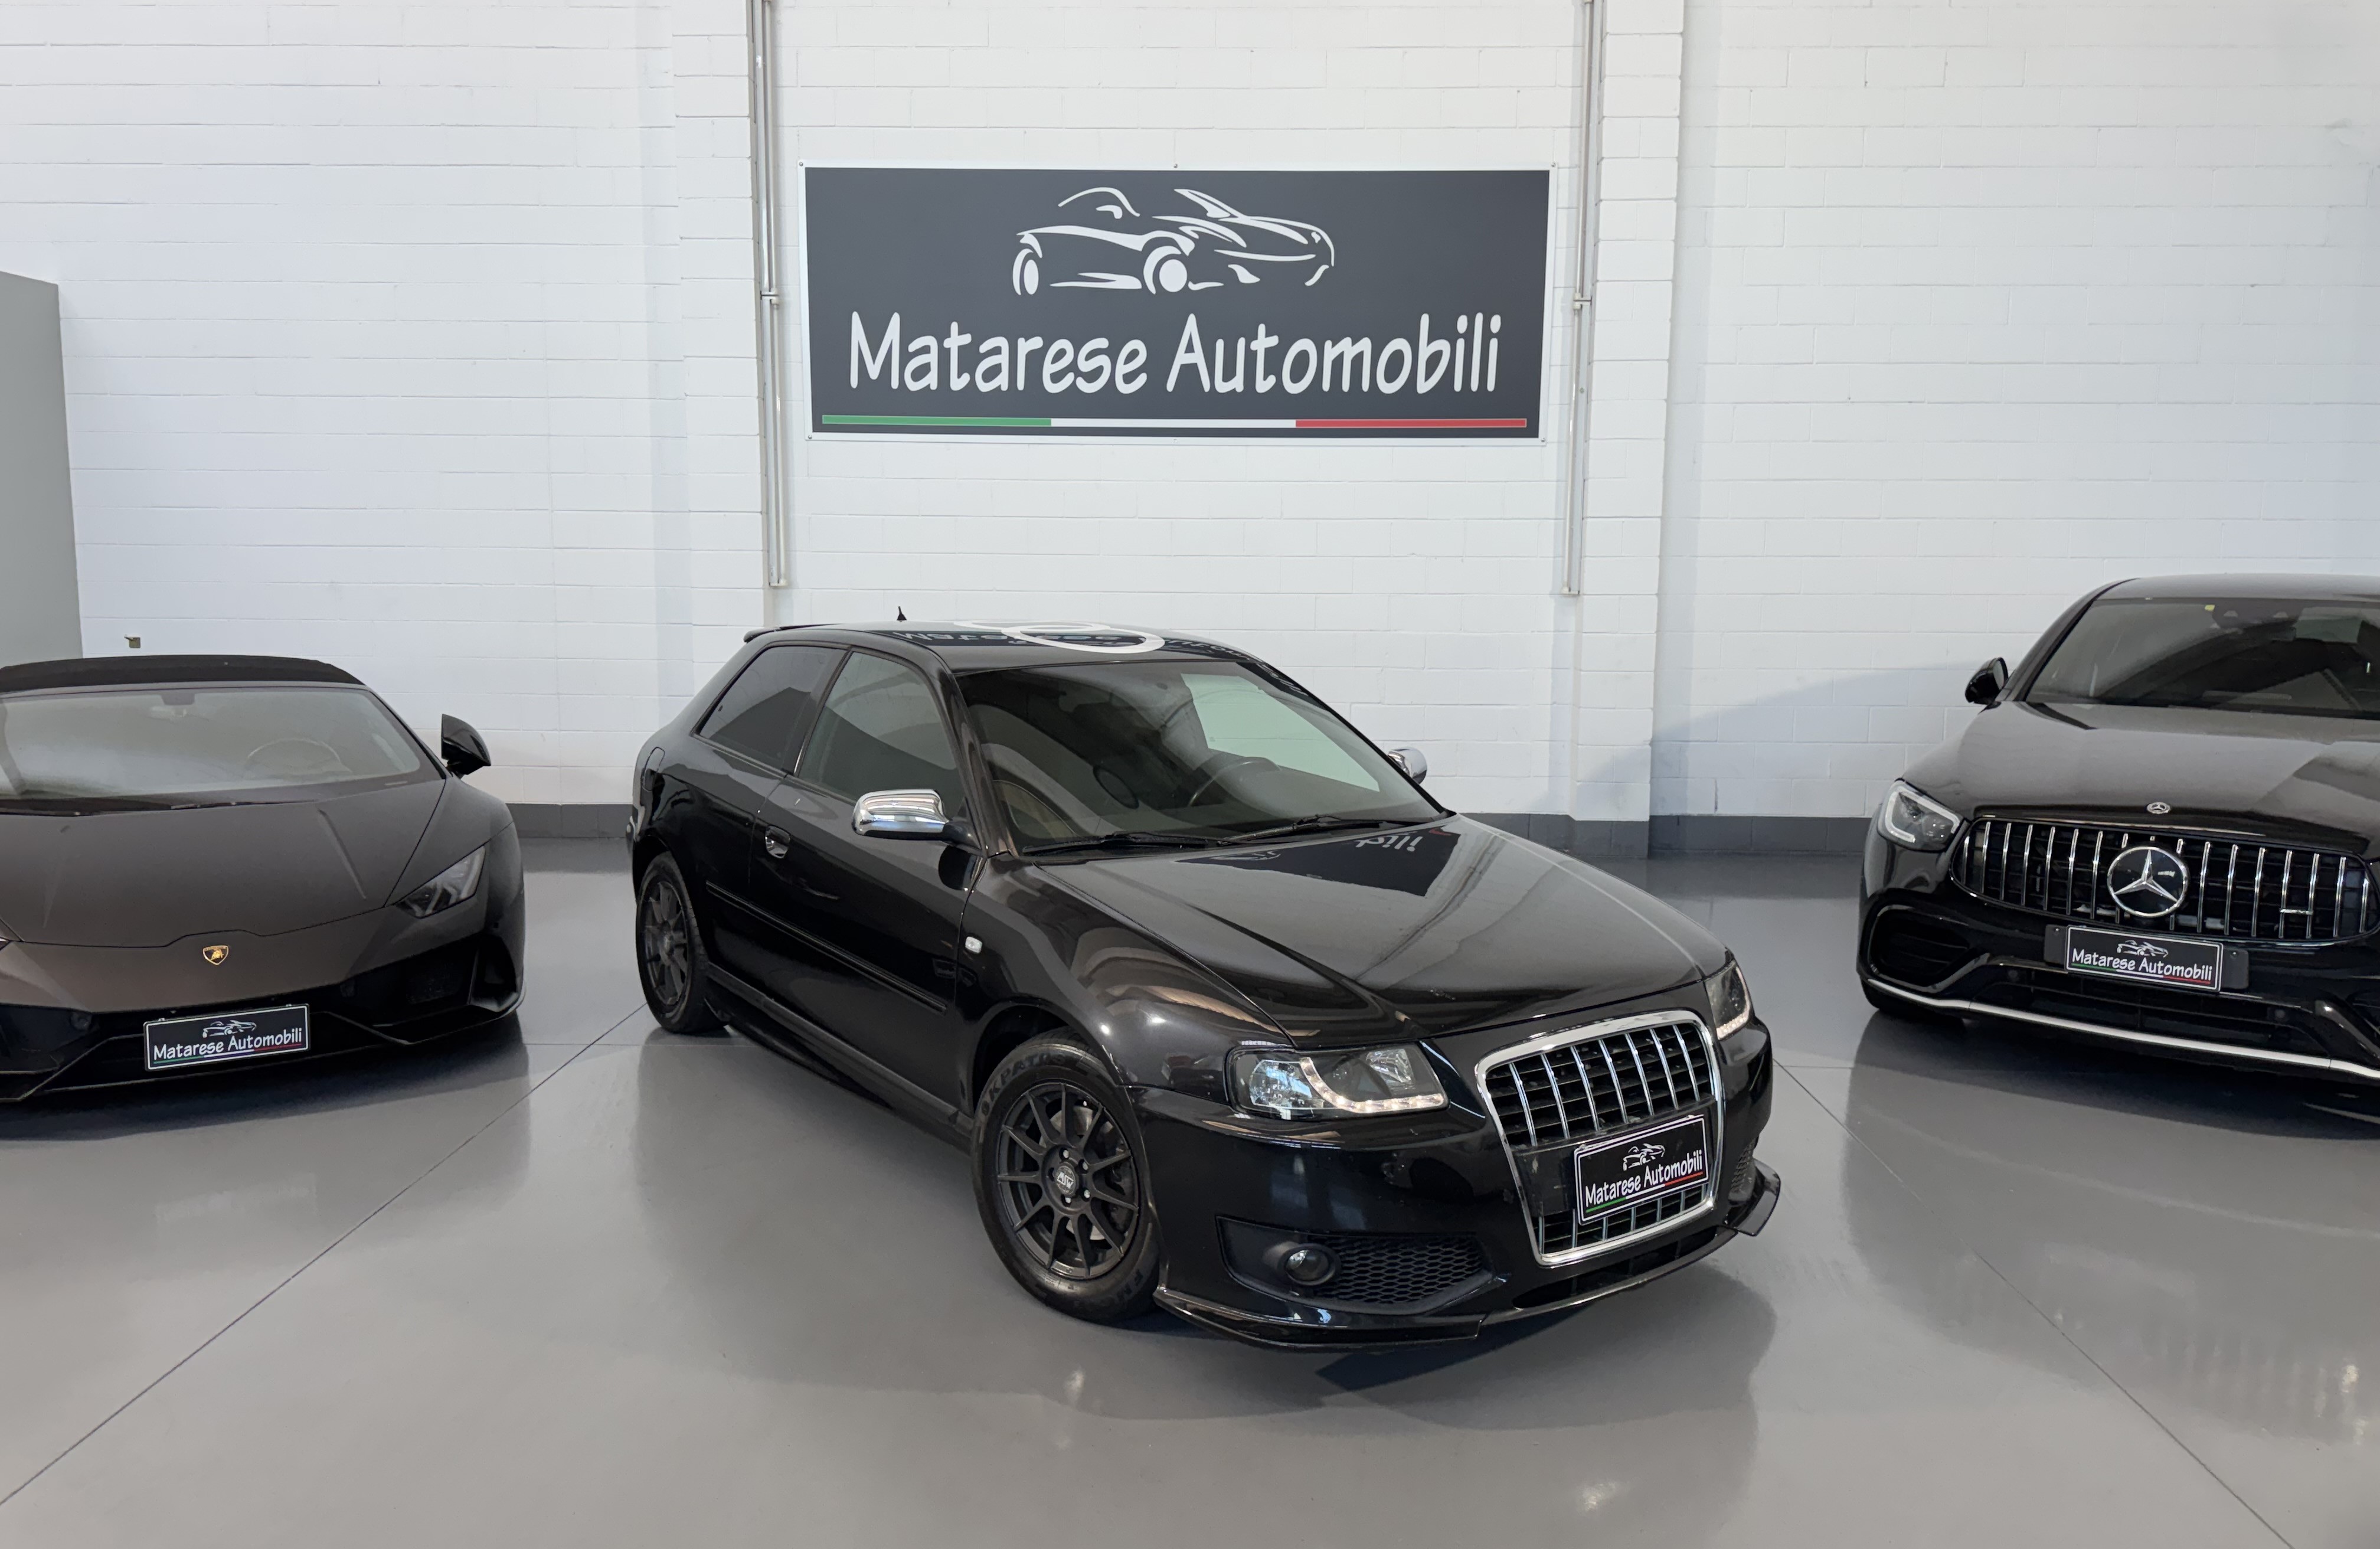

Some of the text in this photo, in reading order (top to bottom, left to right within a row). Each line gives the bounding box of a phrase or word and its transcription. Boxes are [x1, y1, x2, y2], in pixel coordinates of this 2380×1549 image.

[850, 311, 1502, 394] Matarese Automobili
[2072, 948, 2212, 981] Matarese Automobili
[153, 1027, 302, 1060] Matarese Automobili
[1057, 1171, 1074, 1189] MSW
[1585, 1149, 1702, 1207] Matarese Automobili
